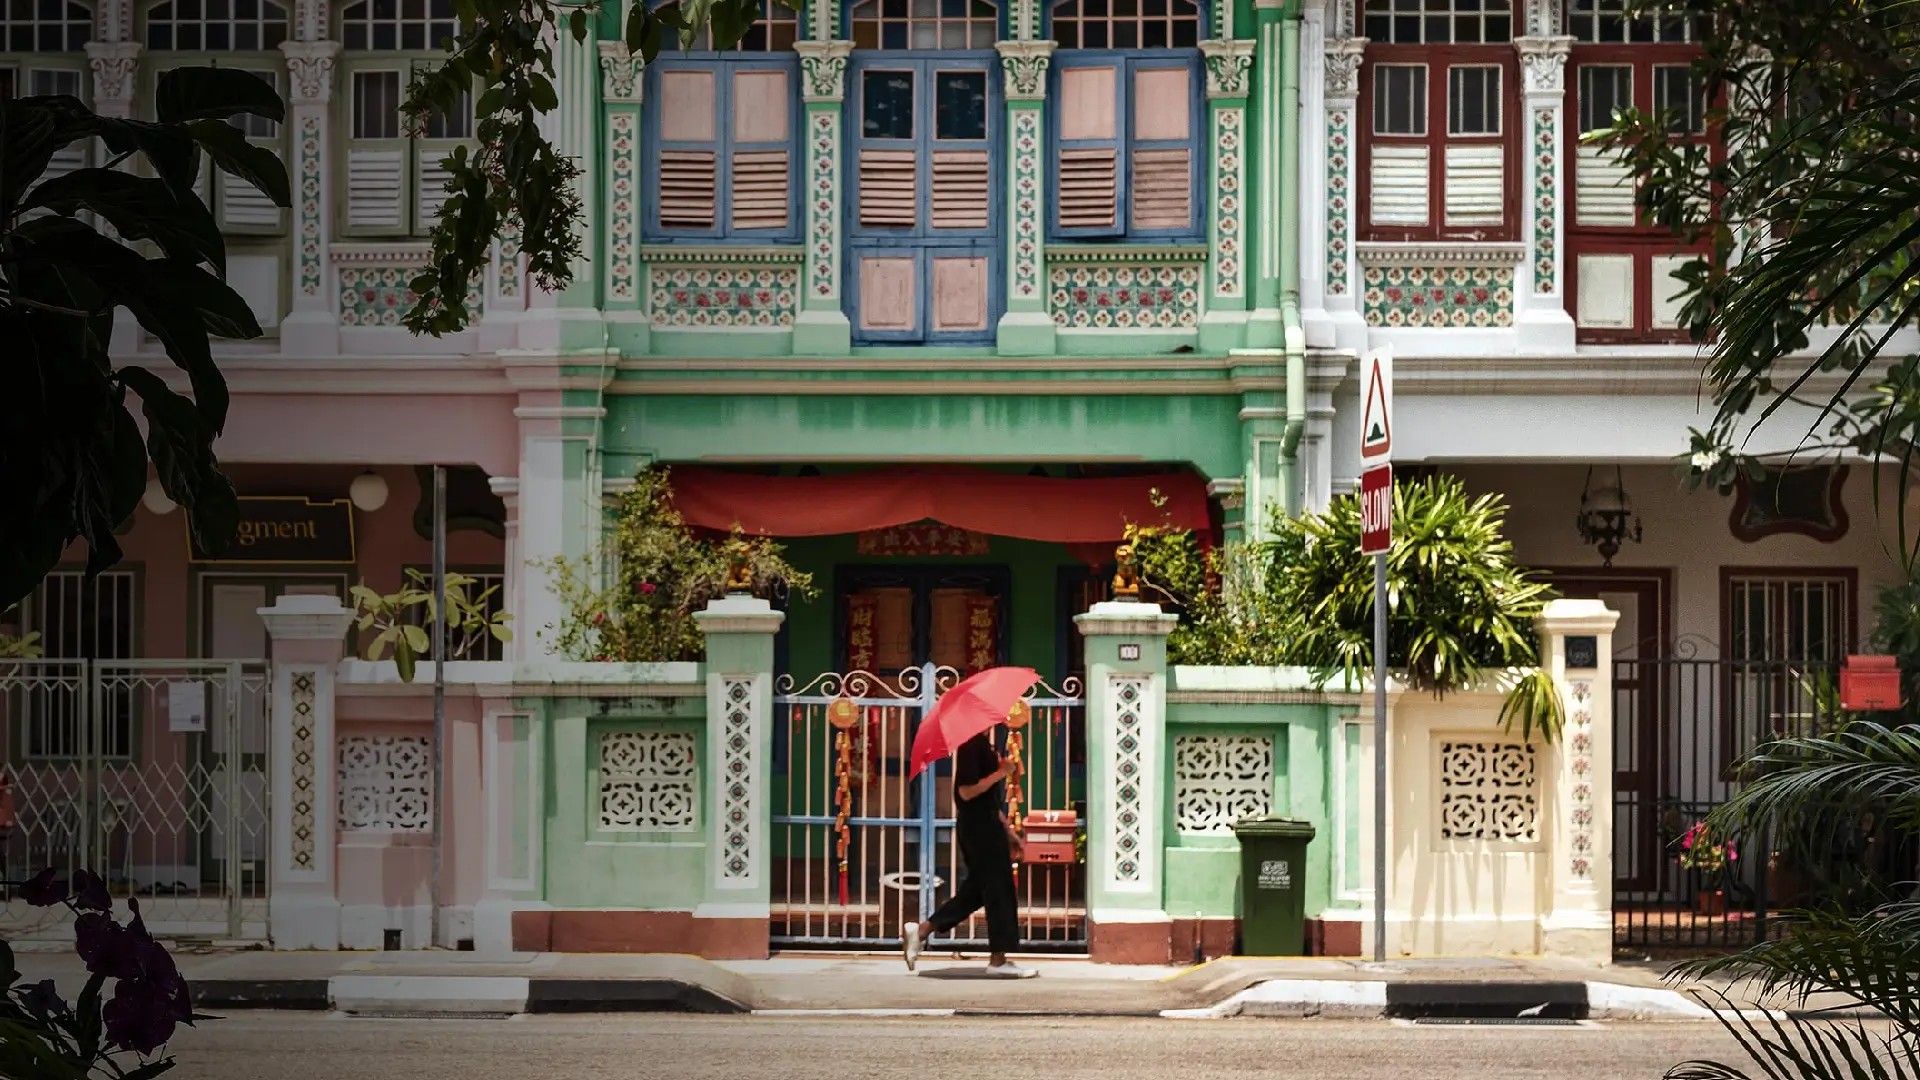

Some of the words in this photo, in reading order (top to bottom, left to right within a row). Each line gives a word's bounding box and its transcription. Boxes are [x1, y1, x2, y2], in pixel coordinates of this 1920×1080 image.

[1361, 485, 1390, 534] SLOW
[236, 519, 317, 546] gment
[1044, 811, 1060, 823] 17
